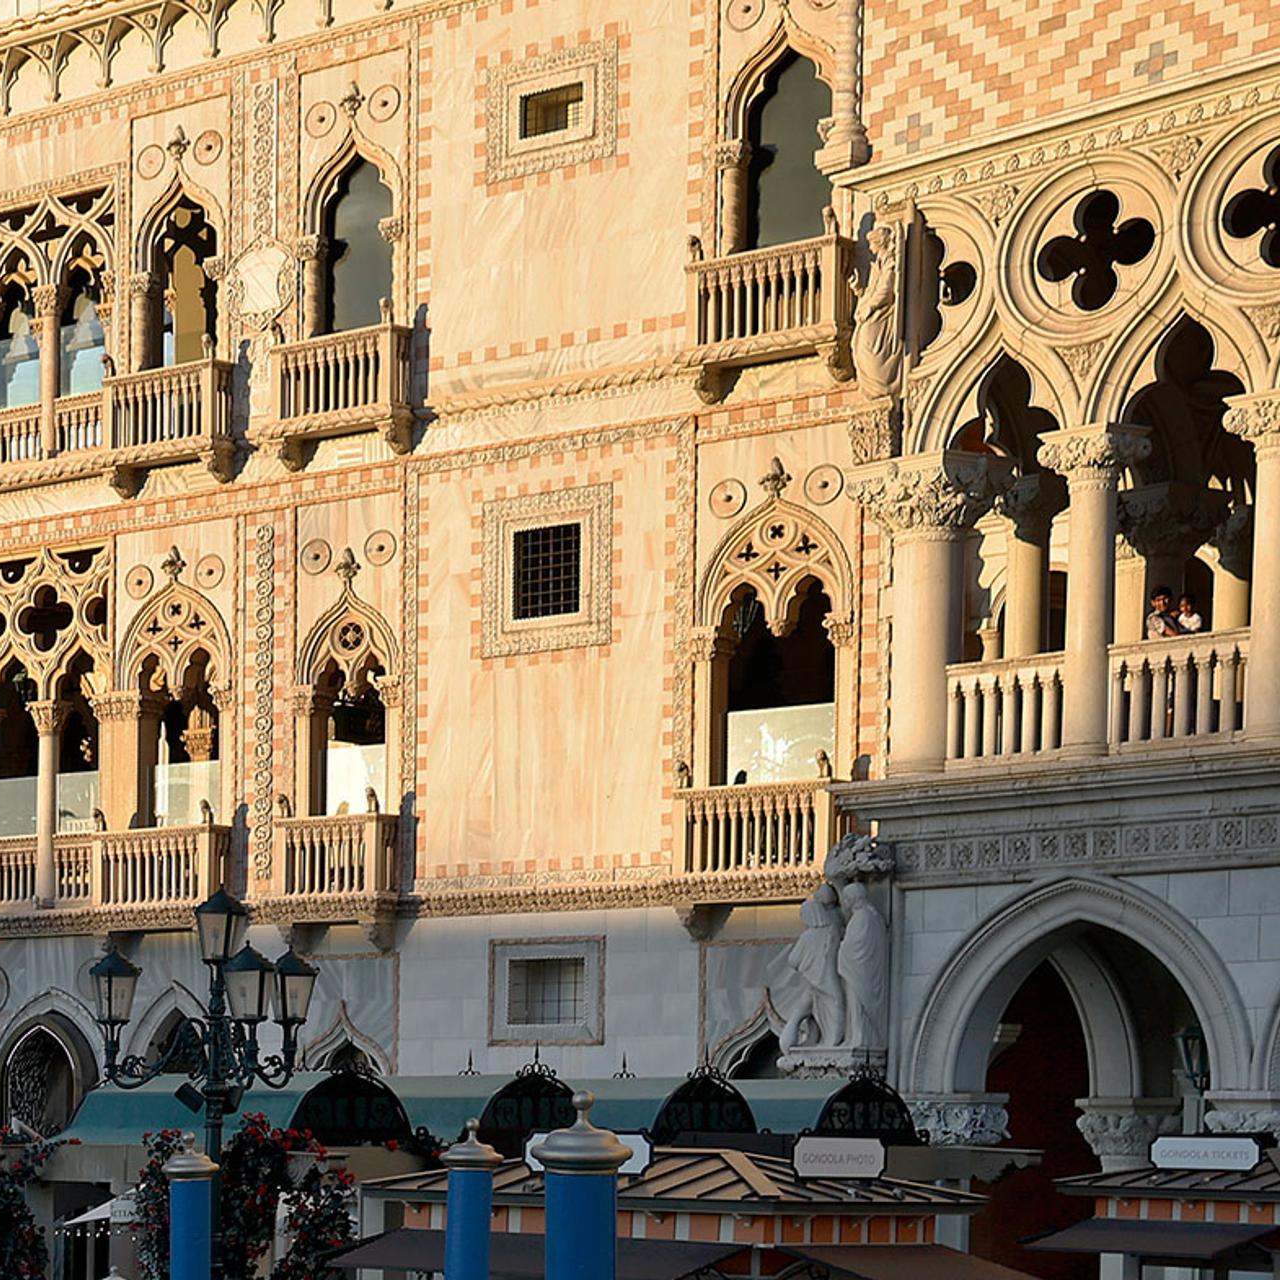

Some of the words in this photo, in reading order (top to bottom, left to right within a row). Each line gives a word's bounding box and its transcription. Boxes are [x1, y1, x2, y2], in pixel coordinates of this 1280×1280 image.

[802, 1153, 845, 1164] GONDOLA
[847, 1153, 875, 1165] PHOTO
[1161, 1150, 1209, 1160] GONDOLA
[1212, 1150, 1249, 1160] TICKETS
